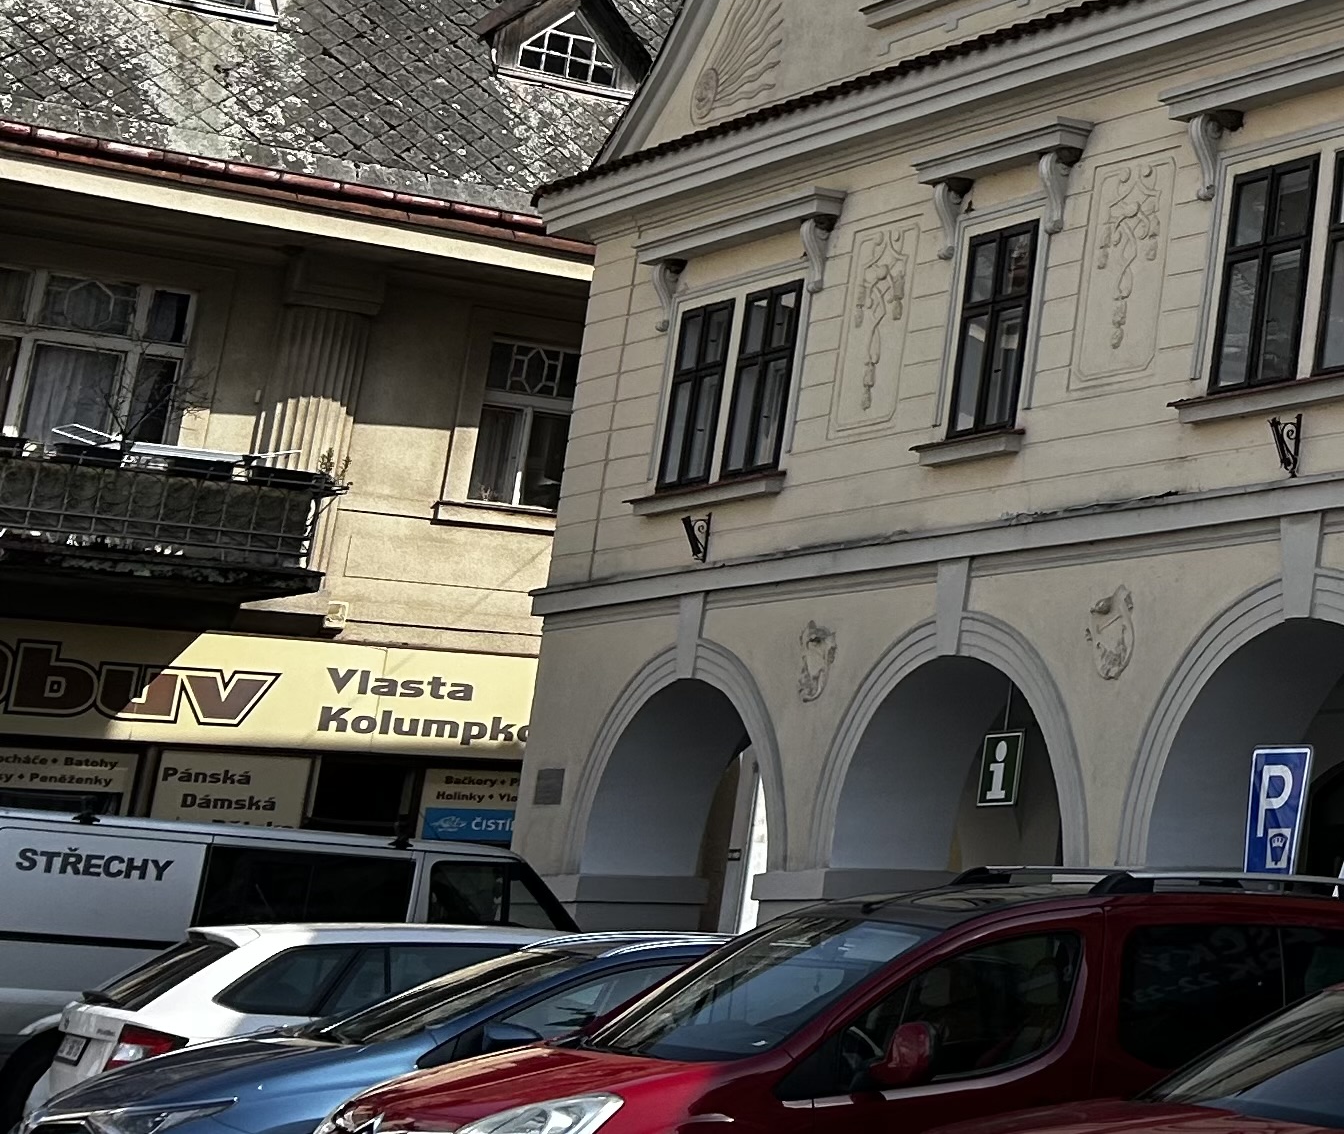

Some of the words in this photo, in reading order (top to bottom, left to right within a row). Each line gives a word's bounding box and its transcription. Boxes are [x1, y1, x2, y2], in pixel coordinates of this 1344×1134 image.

[0, 639, 282, 727] buv
[327, 667, 473, 701] Vlasta
[64, 756, 119, 770] Batohy
[29, 773, 113, 787] Peněženky
[162, 767, 251, 785] Pánská
[444, 775, 498, 787] Bačkory
[180, 792, 276, 811] Dámská
[436, 791, 485, 803] Holinky
[1256, 764, 1293, 837] P
[471, 817, 513, 831] ČISTÍ
[15, 846, 175, 881] STŘECHY
